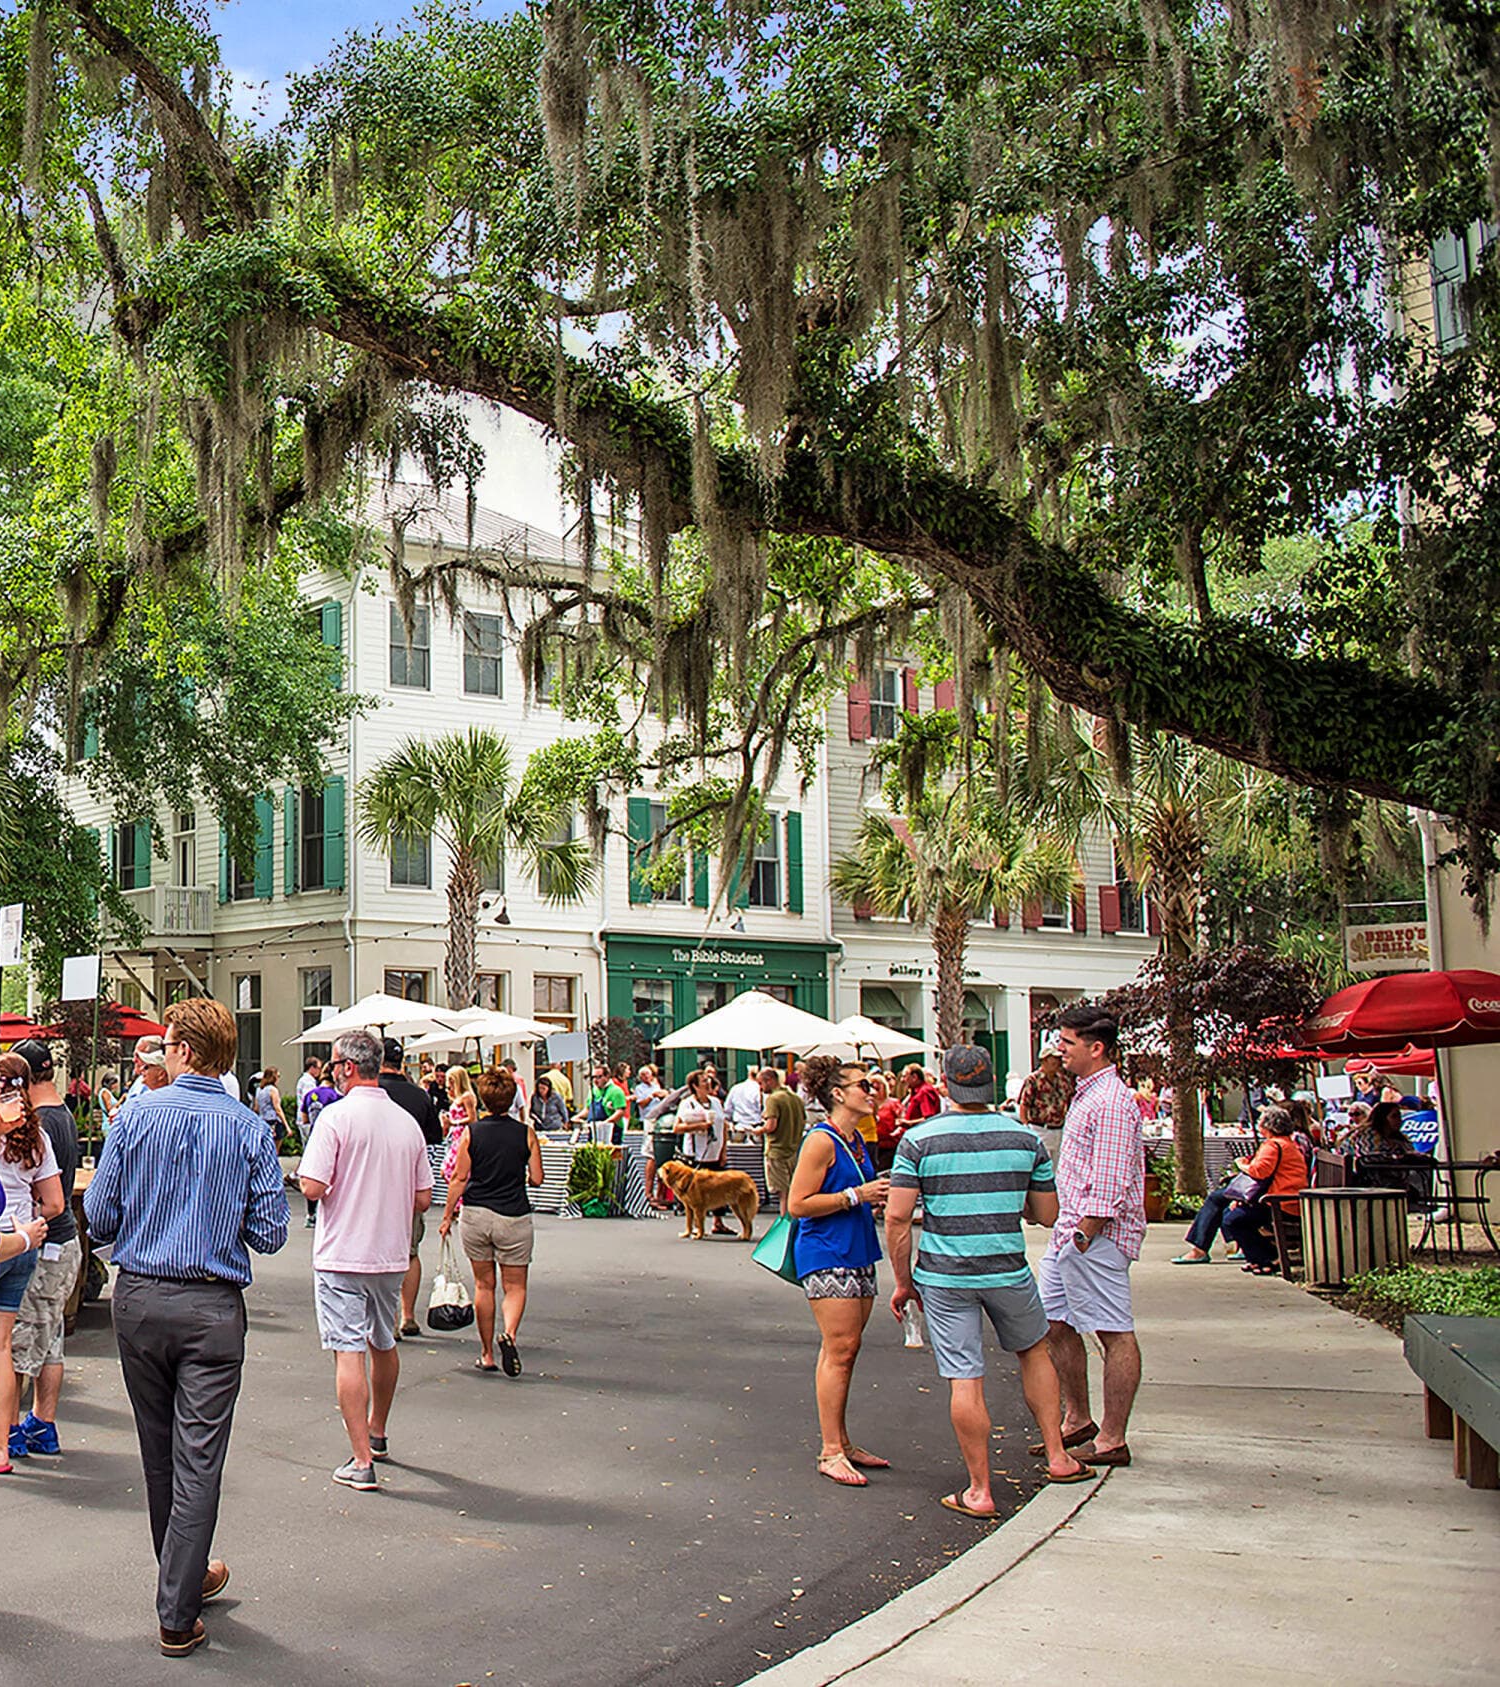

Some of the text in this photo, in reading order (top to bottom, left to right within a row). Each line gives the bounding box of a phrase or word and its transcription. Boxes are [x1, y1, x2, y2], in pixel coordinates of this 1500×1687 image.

[1373, 941, 1414, 953] GRILL
[672, 949, 765, 966] The Bible Student
[888, 964, 924, 978] gallery
[1399, 1119, 1439, 1132] BUD
[1407, 1132, 1440, 1143] GHT
